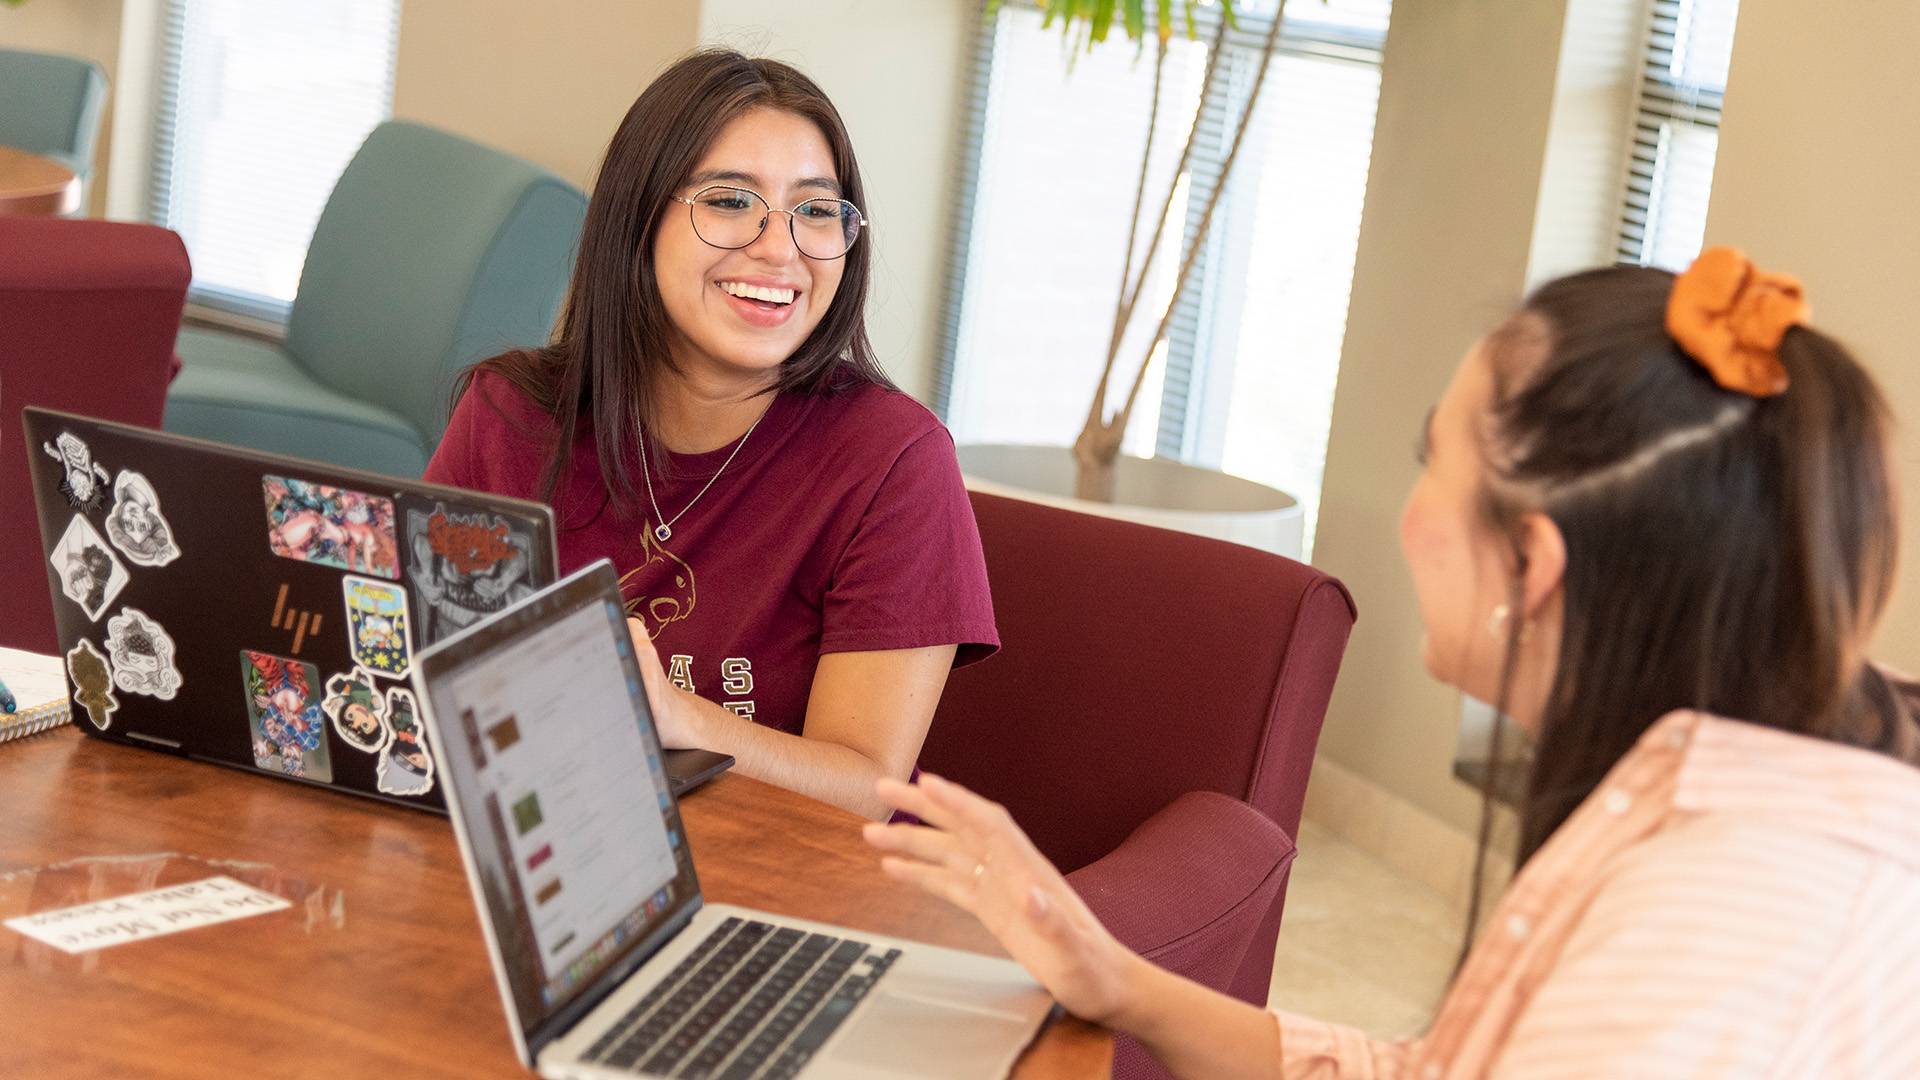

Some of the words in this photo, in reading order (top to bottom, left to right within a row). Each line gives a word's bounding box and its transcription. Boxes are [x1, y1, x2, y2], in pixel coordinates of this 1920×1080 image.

[141, 880, 227, 903] Table
[223, 891, 277, 908] Do
[28, 901, 134, 926] Please
[161, 905, 224, 926] Not
[60, 918, 157, 944] Move
